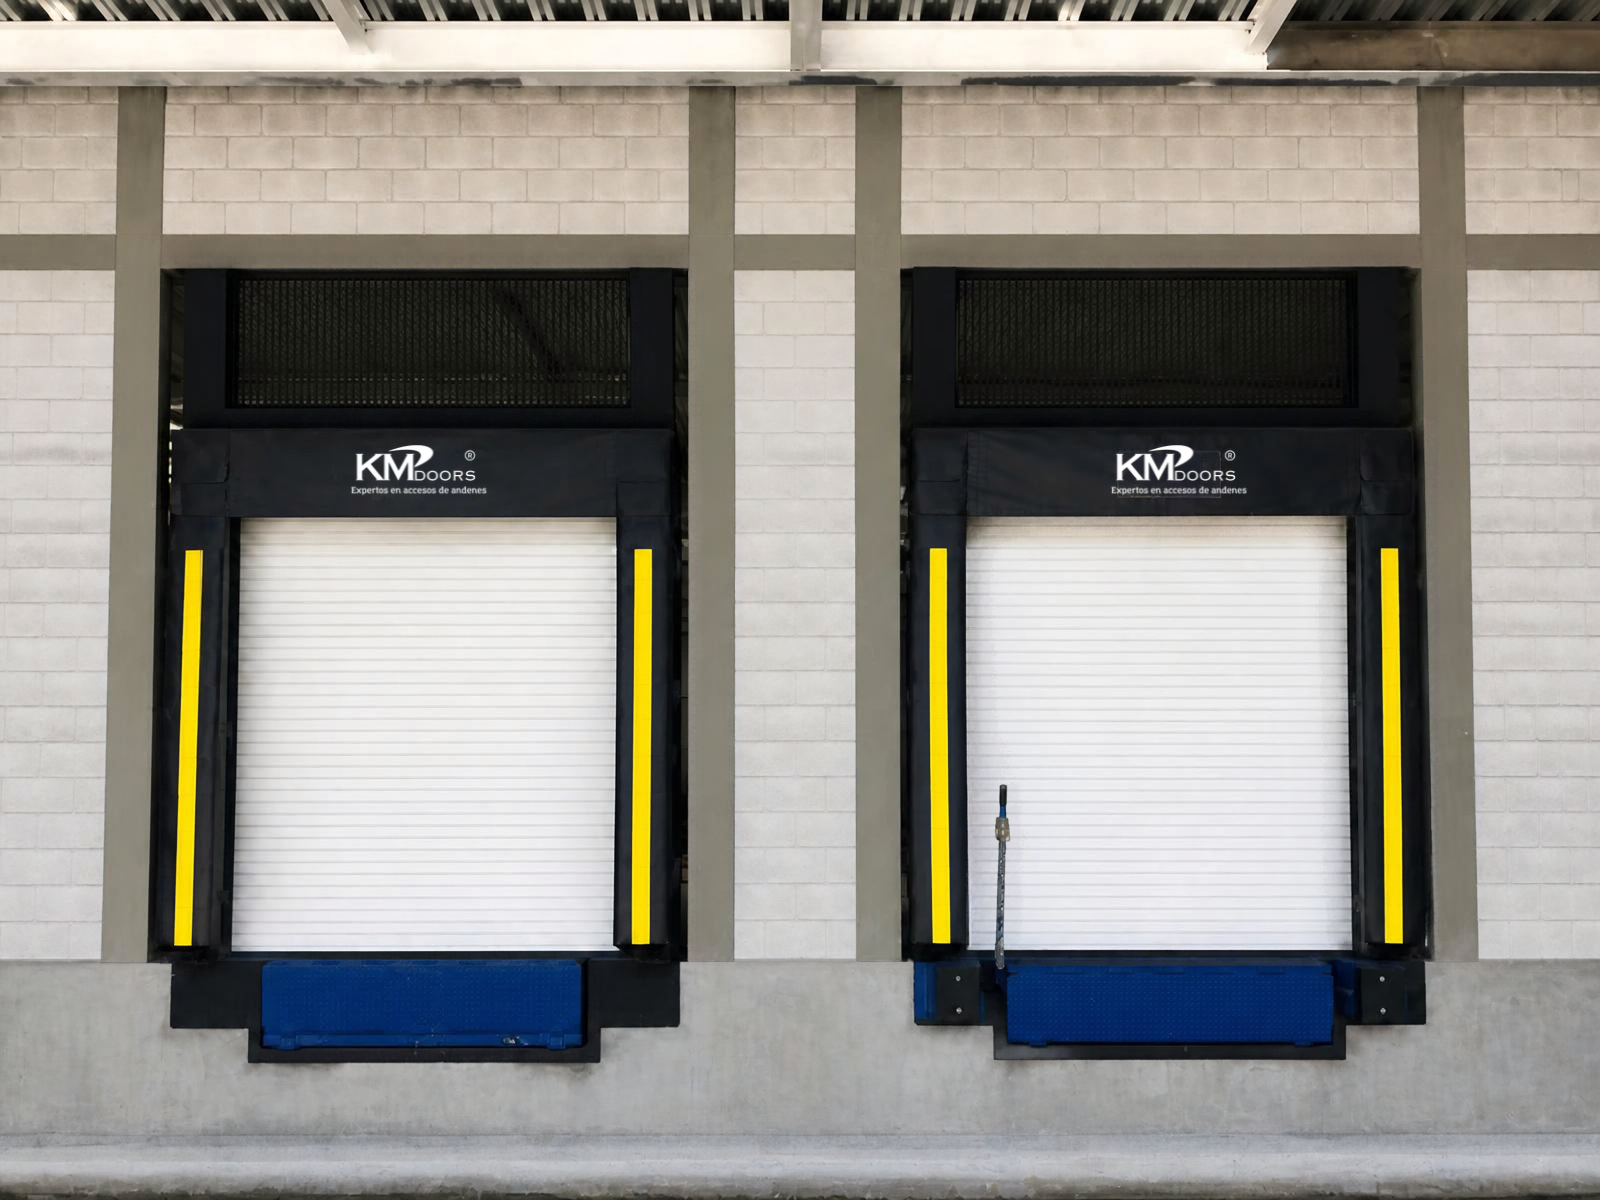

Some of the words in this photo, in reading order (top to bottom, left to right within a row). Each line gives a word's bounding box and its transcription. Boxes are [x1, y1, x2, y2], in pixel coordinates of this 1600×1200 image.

[414, 470, 476, 481] DOORS
[1174, 470, 1236, 481] DOORS
[351, 486, 389, 495] Expertos
[438, 486, 449, 494] de
[451, 486, 487, 494] andenes
[1111, 486, 1149, 495] Expertos
[1198, 486, 1209, 494] de
[1211, 486, 1247, 494] andenes
